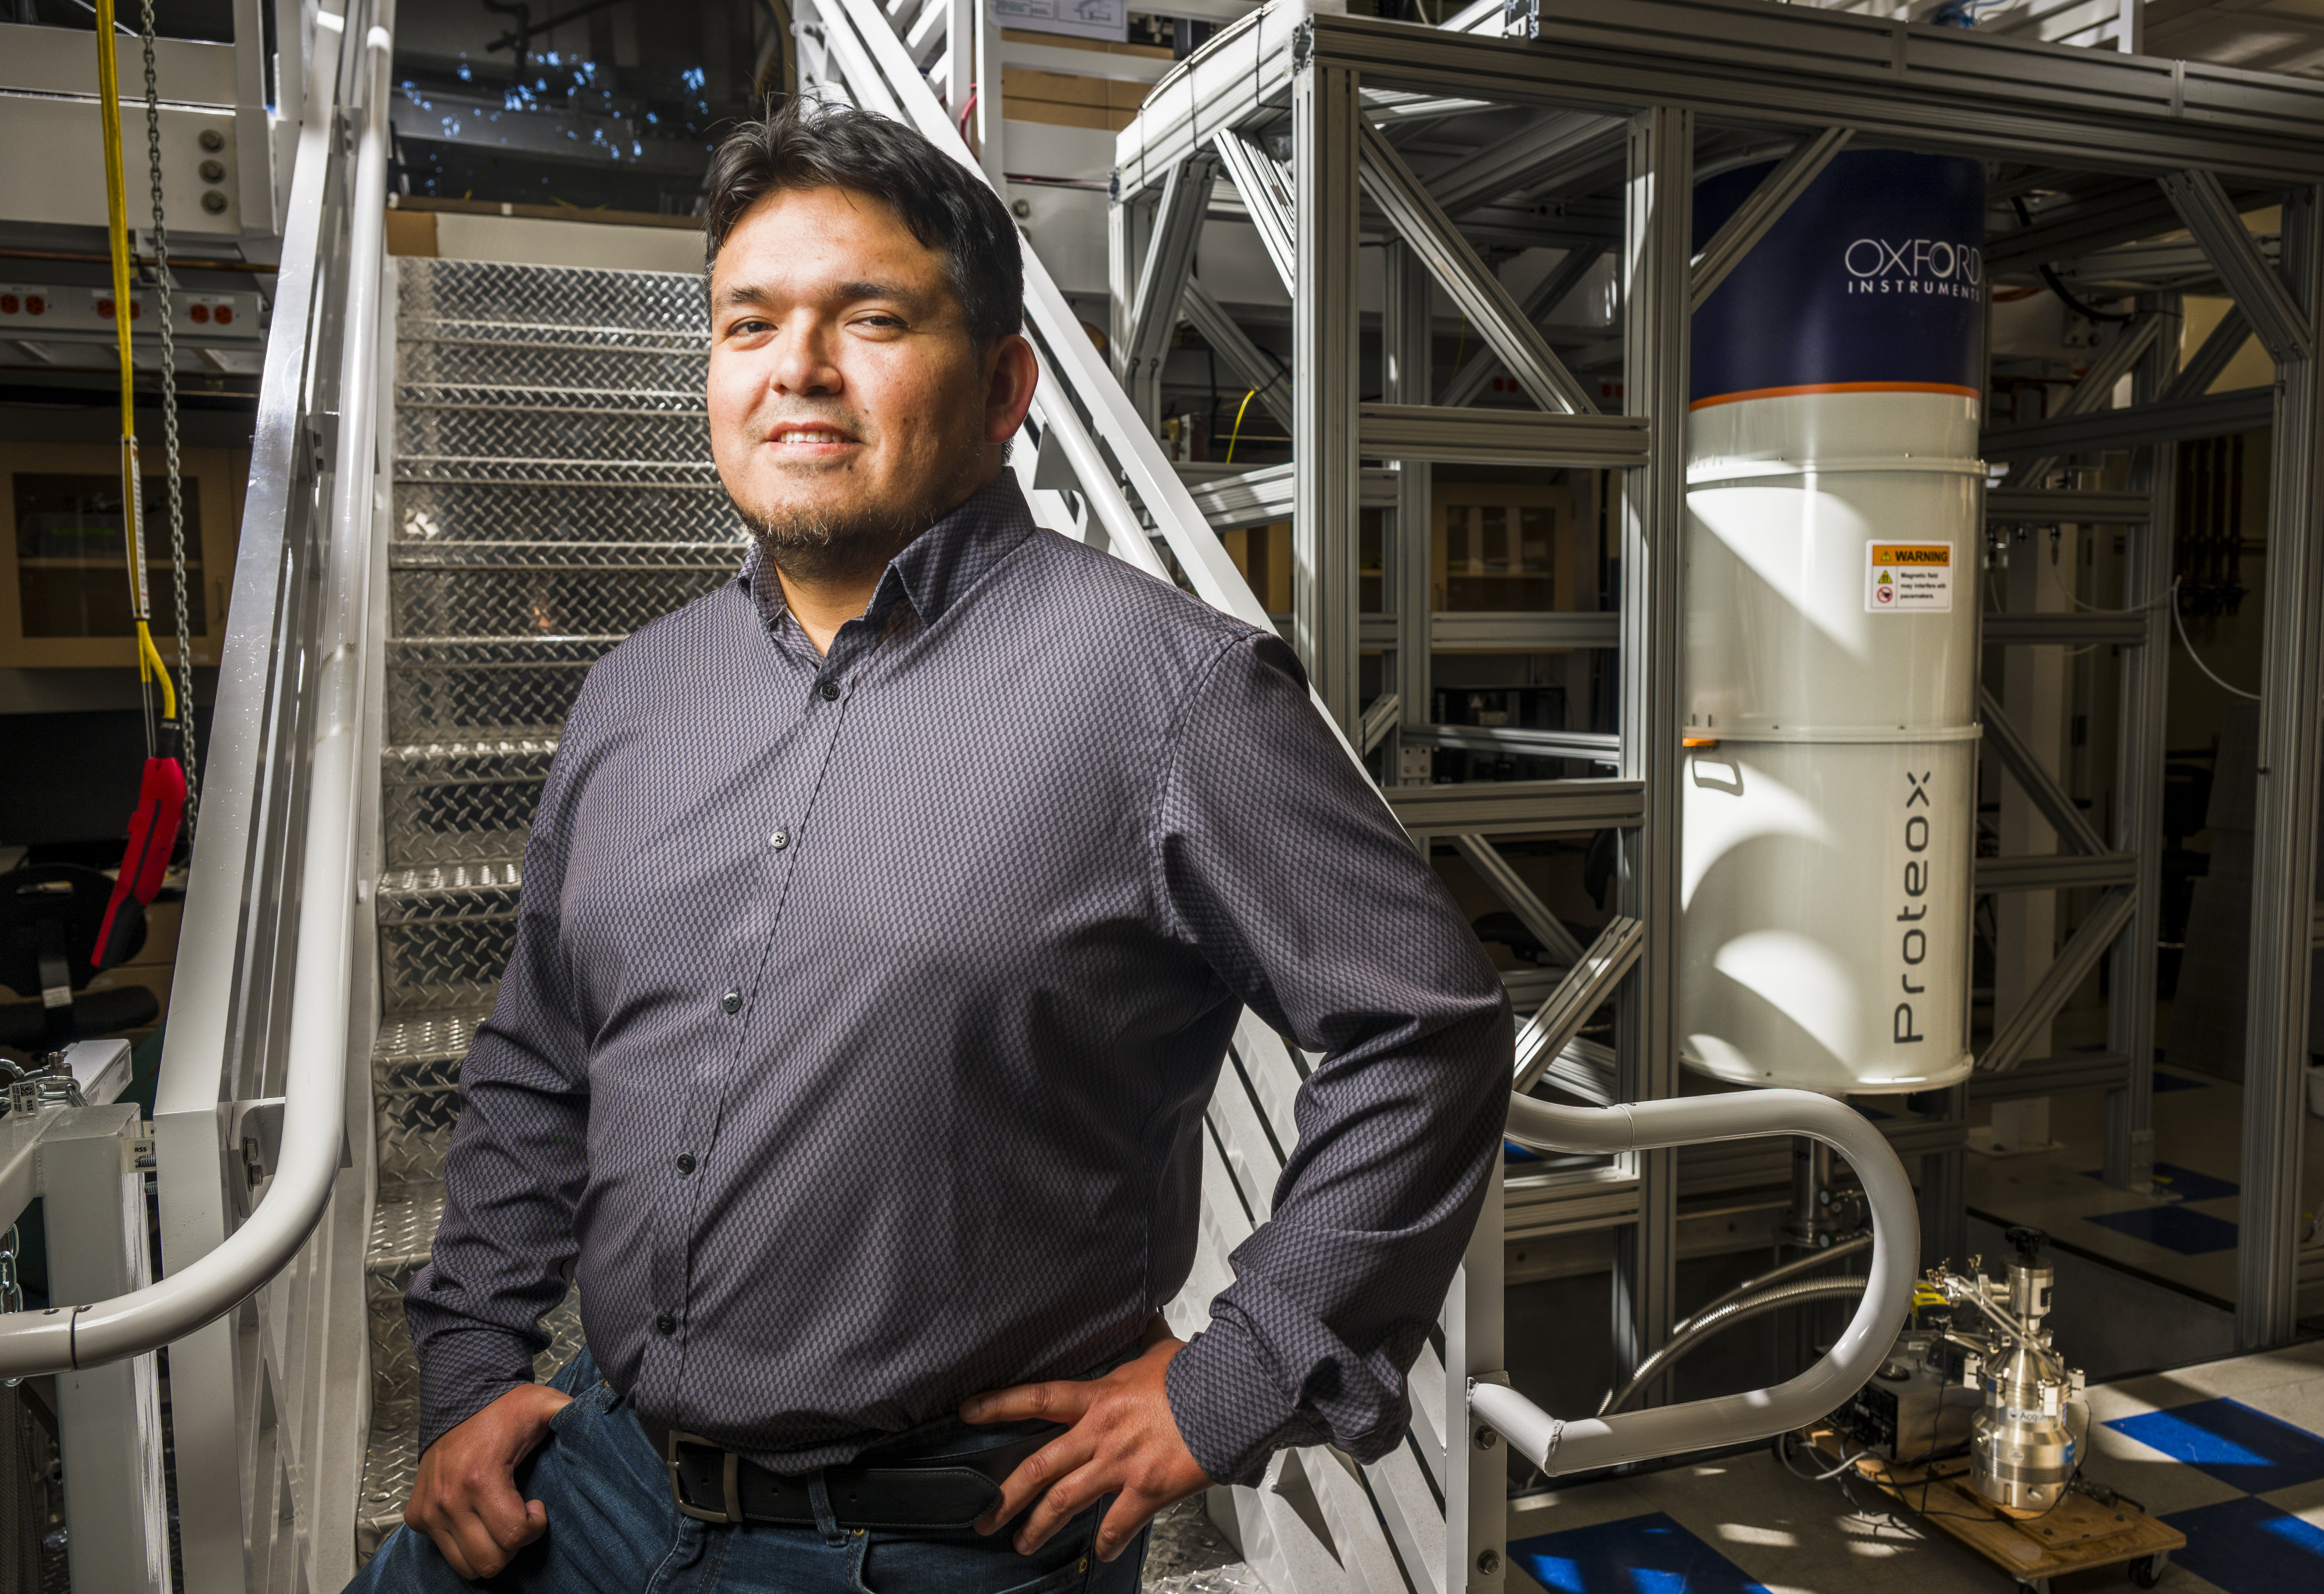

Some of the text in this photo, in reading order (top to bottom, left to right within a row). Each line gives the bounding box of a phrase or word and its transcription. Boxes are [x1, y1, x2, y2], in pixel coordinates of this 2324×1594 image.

[1845, 239, 1982, 285] OXFORD
[1848, 280, 1980, 303] INSTRUMENTS
[1895, 551, 1948, 562] WARNING
[1893, 771, 1931, 1044] Proteox
